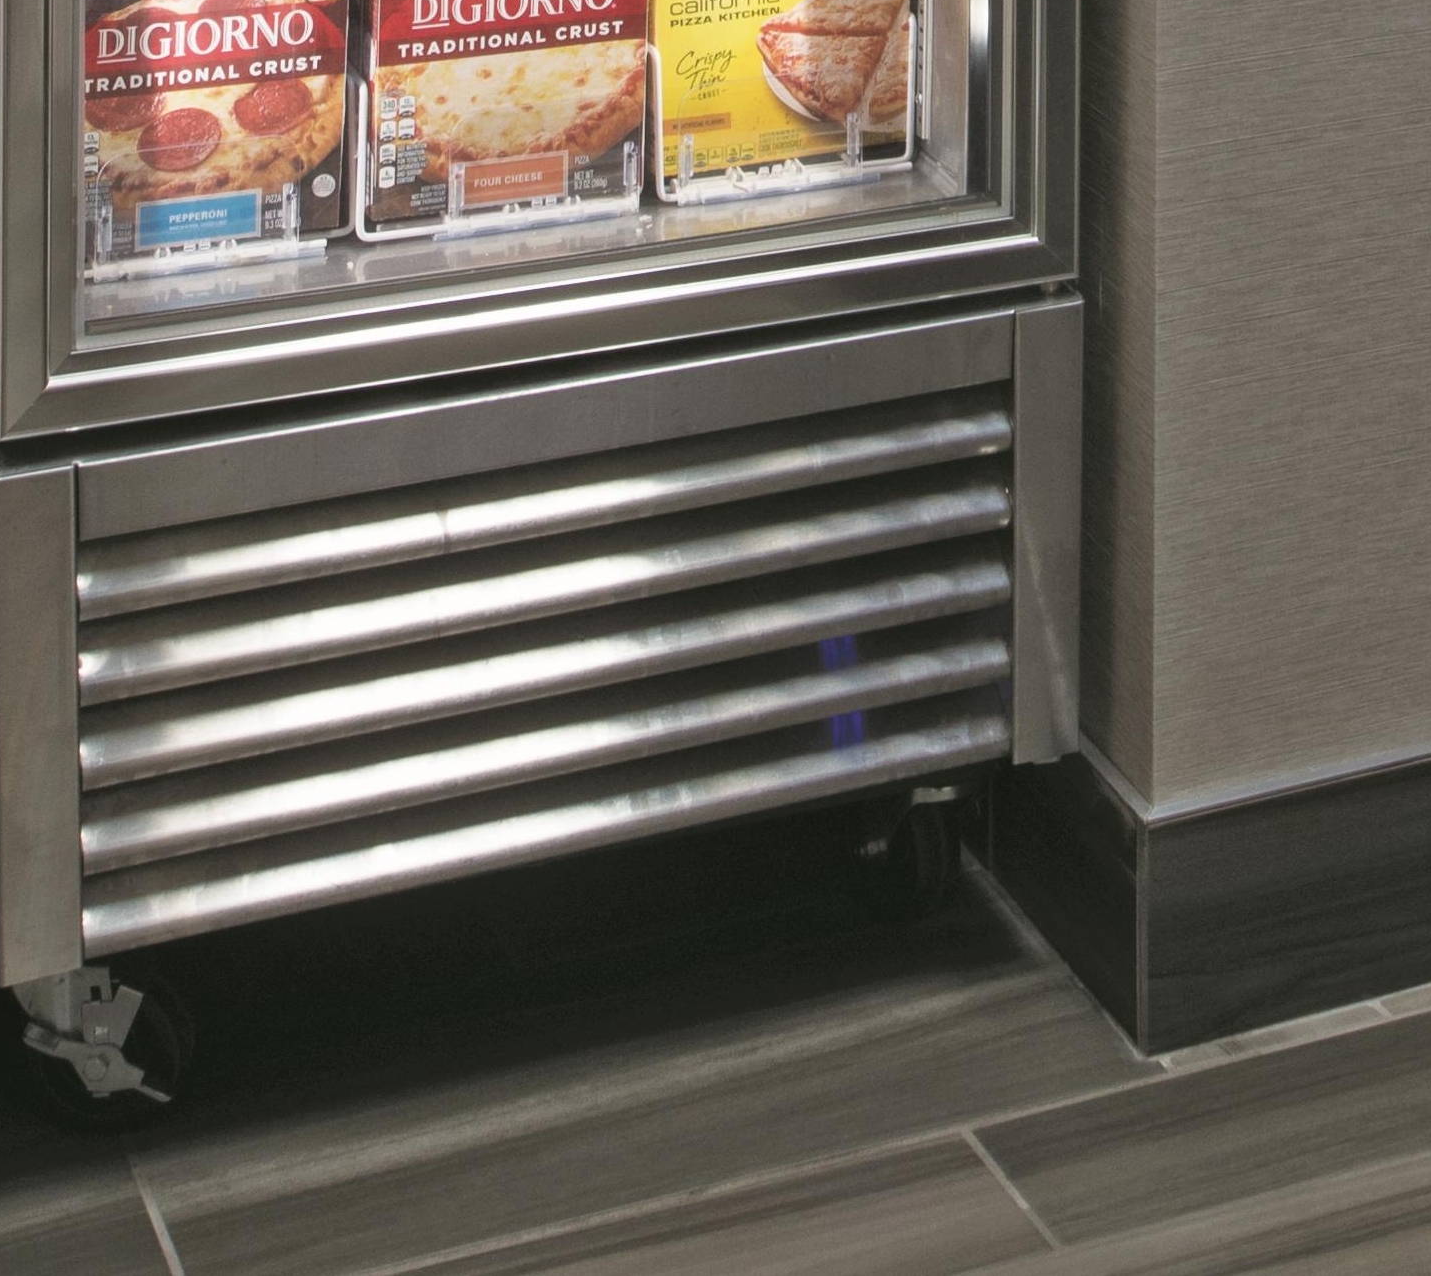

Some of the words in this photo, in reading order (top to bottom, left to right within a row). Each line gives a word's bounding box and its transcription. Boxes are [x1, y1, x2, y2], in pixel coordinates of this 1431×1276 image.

[669, 14, 713, 28] PIZZA
[97, 7, 315, 66] DIGIORNO
[398, 29, 548, 59] TRADITIONAL
[555, 20, 625, 41] CRUST
[84, 64, 241, 94] TRADITIONAL
[248, 54, 324, 78] CRUST
[675, 48, 738, 77] Crispy
[473, 176, 502, 189] FOUR
[504, 171, 544, 184] CHEESE
[168, 207, 229, 225] PEPPERONI
